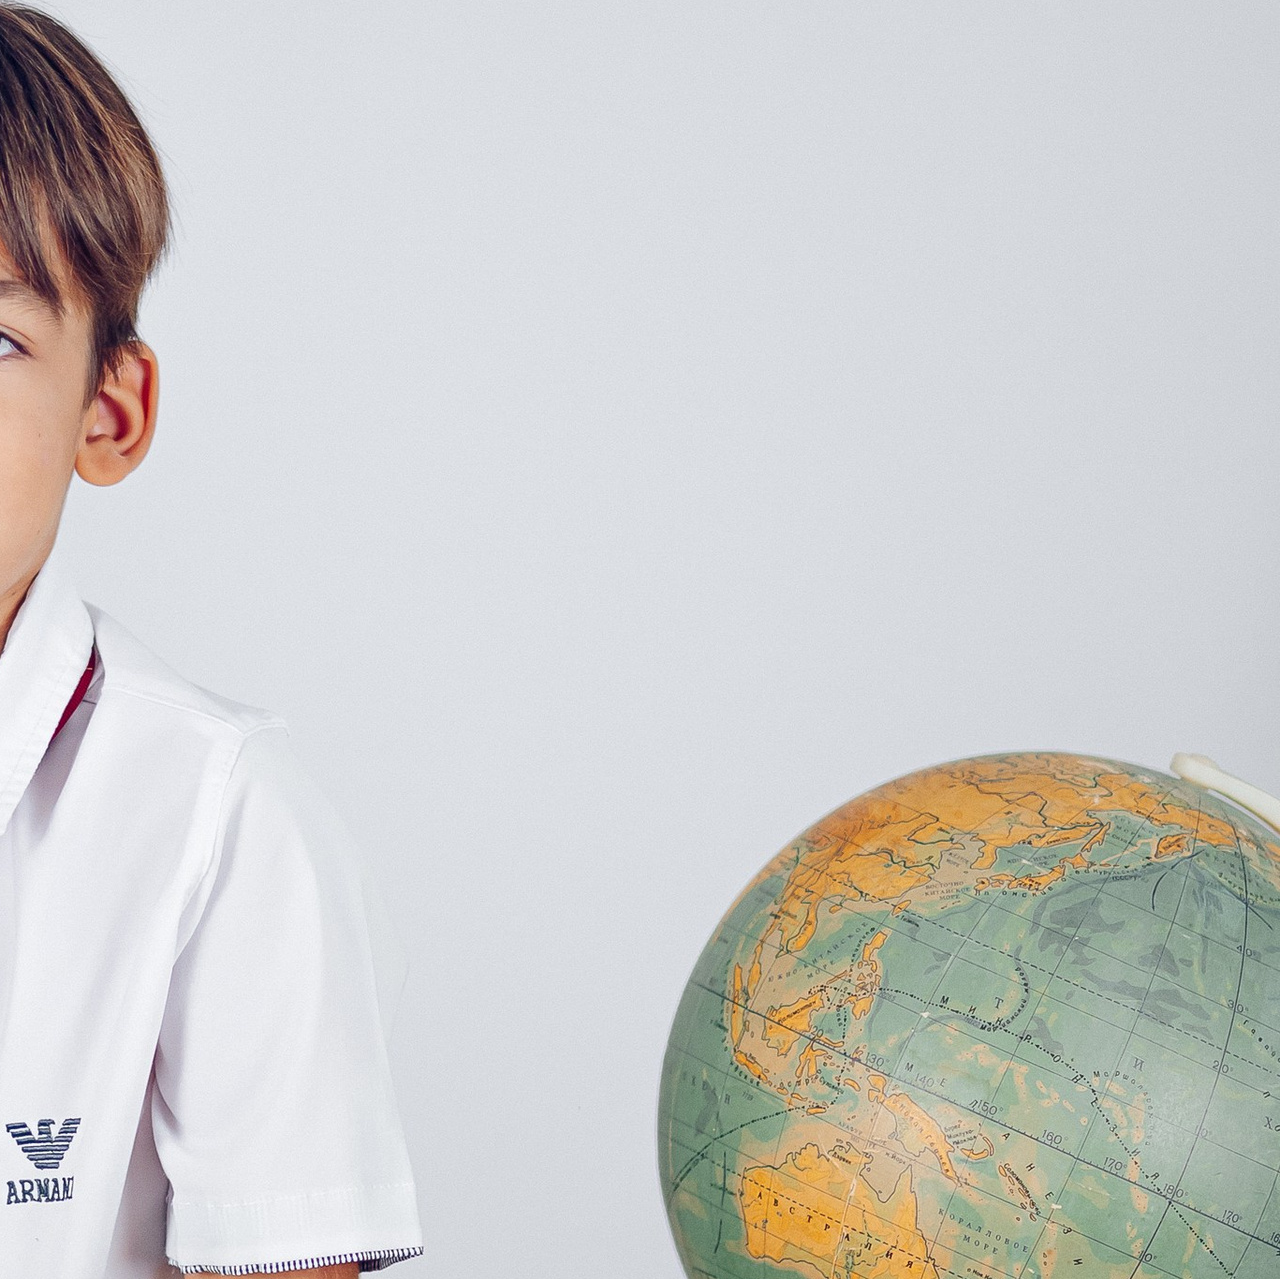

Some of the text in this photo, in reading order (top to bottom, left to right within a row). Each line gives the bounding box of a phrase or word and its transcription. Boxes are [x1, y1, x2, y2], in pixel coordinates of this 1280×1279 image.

[756, 1191, 914, 1270] АВСТРАЛИЯ
[937, 1207, 1030, 1254] КОРАЛЛОВОЕ
[962, 1234, 999, 1255] МОРЕ
